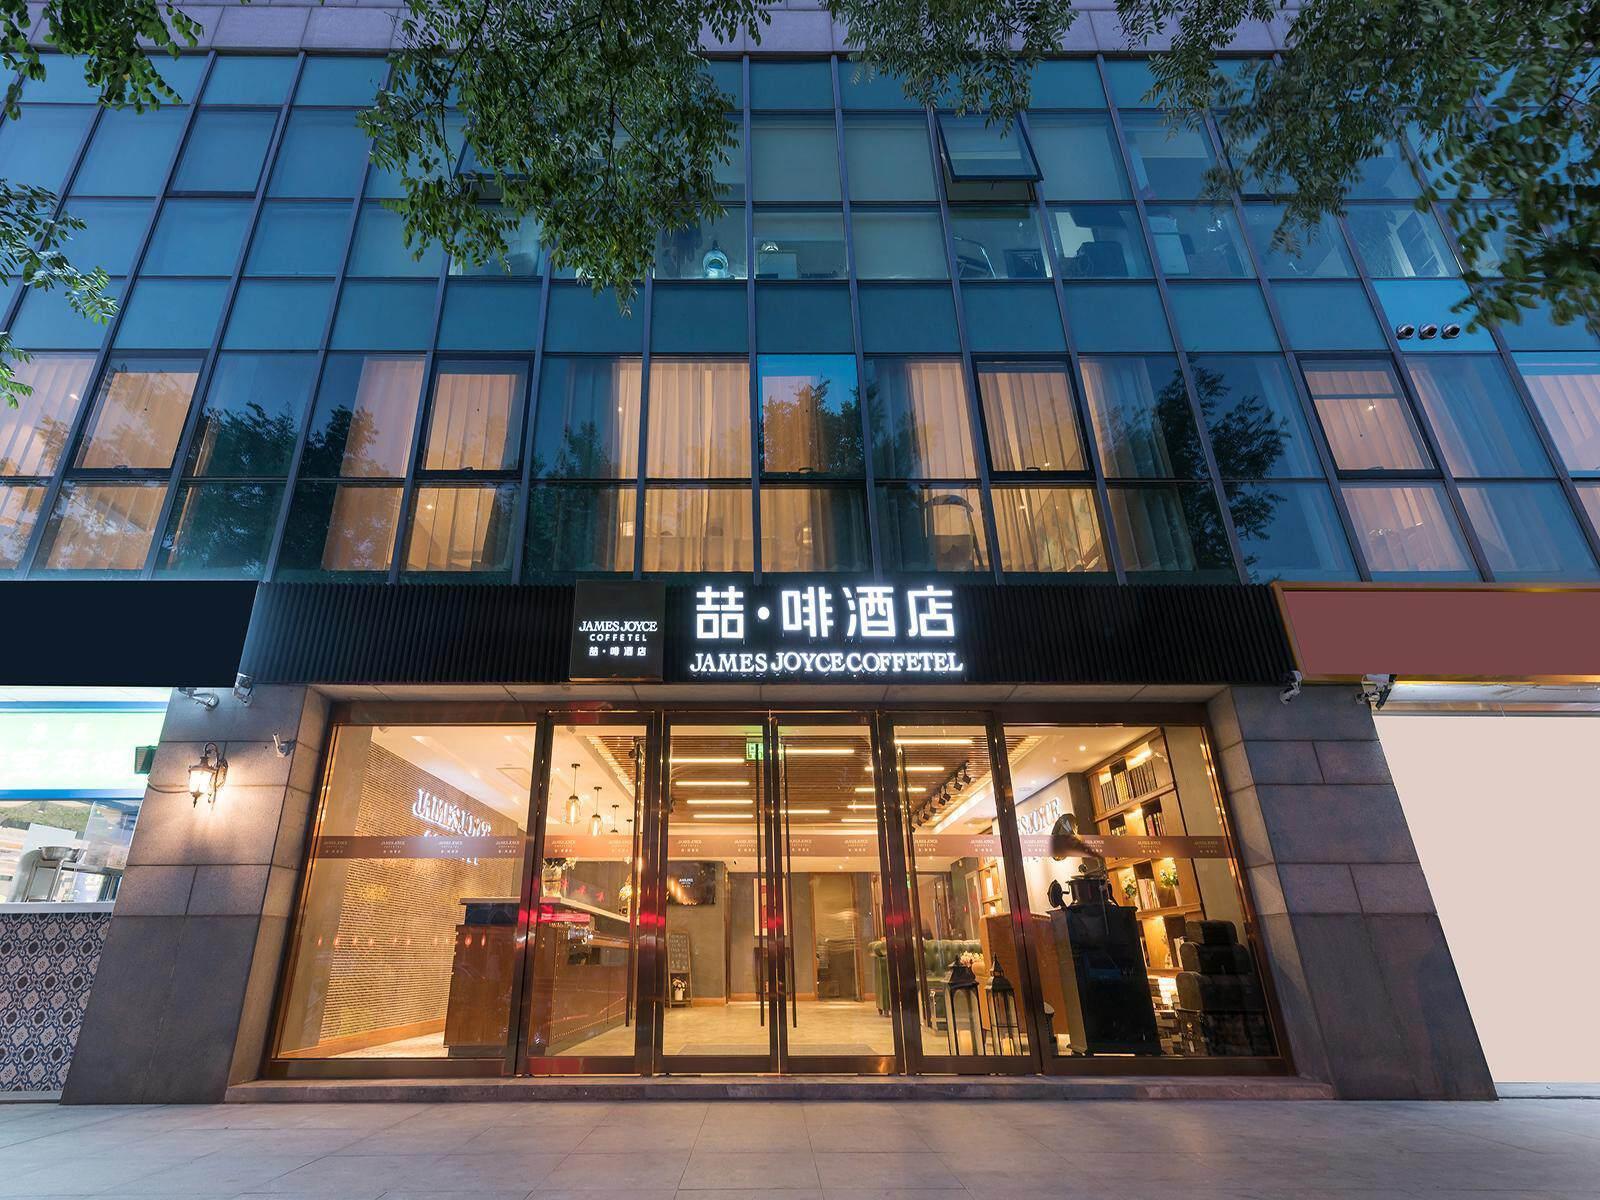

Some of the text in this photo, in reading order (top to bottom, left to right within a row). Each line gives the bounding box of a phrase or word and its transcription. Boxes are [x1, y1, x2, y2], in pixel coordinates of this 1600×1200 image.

[696, 585, 955, 639] 喆·啡酒店
[578, 620, 658, 632] JAMES JOYCE
[589, 633, 647, 642] COFFETEL
[690, 651, 964, 673] JAMES JOYCE COFFETEL
